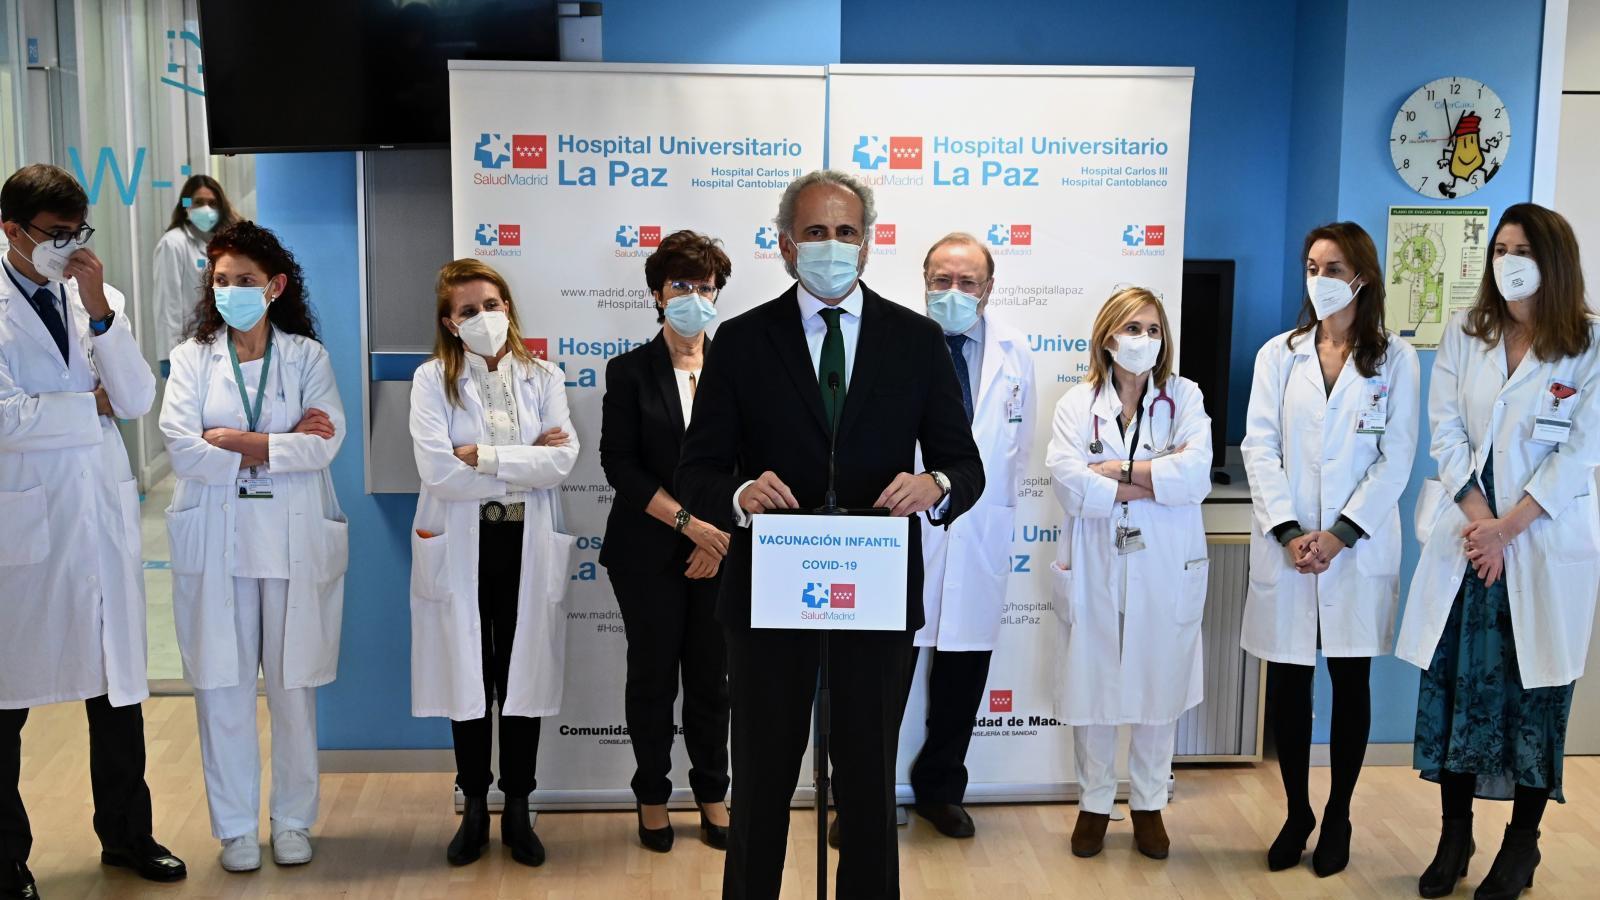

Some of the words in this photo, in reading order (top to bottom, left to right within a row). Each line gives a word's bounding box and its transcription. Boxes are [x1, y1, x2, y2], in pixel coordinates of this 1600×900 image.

[1450, 84, 1460, 95] 12
[1427, 90, 1435, 101] 11
[1405, 111, 1416, 122] 10
[1494, 108, 1501, 119] 2
[1400, 134, 1407, 144] 9
[558, 135, 651, 157] Hospital
[659, 136, 803, 156] Universitario
[933, 137, 1024, 158] Hospital
[1031, 137, 1168, 156] Universitario
[1403, 159, 1410, 169] 8
[558, 160, 596, 187] La
[608, 161, 669, 188] Paz
[711, 167, 754, 178] Hospital
[756, 167, 790, 177] Carlos
[792, 168, 802, 177] III
[933, 161, 970, 187] La
[982, 161, 1040, 187] Paz
[1081, 166, 1122, 178] Hospital
[1125, 166, 1156, 177] Carlos
[1158, 166, 1168, 176] III
[473, 173, 549, 186] SaludMadrid
[691, 178, 734, 190] Hospital
[736, 179, 790, 189] Cantoblan
[1062, 177, 1103, 189] Hospital
[1105, 178, 1168, 188] Cantoblanco
[1421, 176, 1428, 187] 7
[1471, 174, 1478, 185] 5
[475, 248, 522, 257] SaludMadrid
[615, 249, 654, 258] SaludMad
[597, 299, 658, 311] #HospitalLa
[989, 296, 1048, 307] spitalLaPaz
[759, 534, 841, 546] VACUNACIÓN
[845, 537, 901, 548] INFANTIL
[802, 560, 857, 571] COVID-19
[801, 611, 855, 621] SaludMadrid
[1007, 716, 1024, 727] de
[559, 725, 629, 736] Comunida
